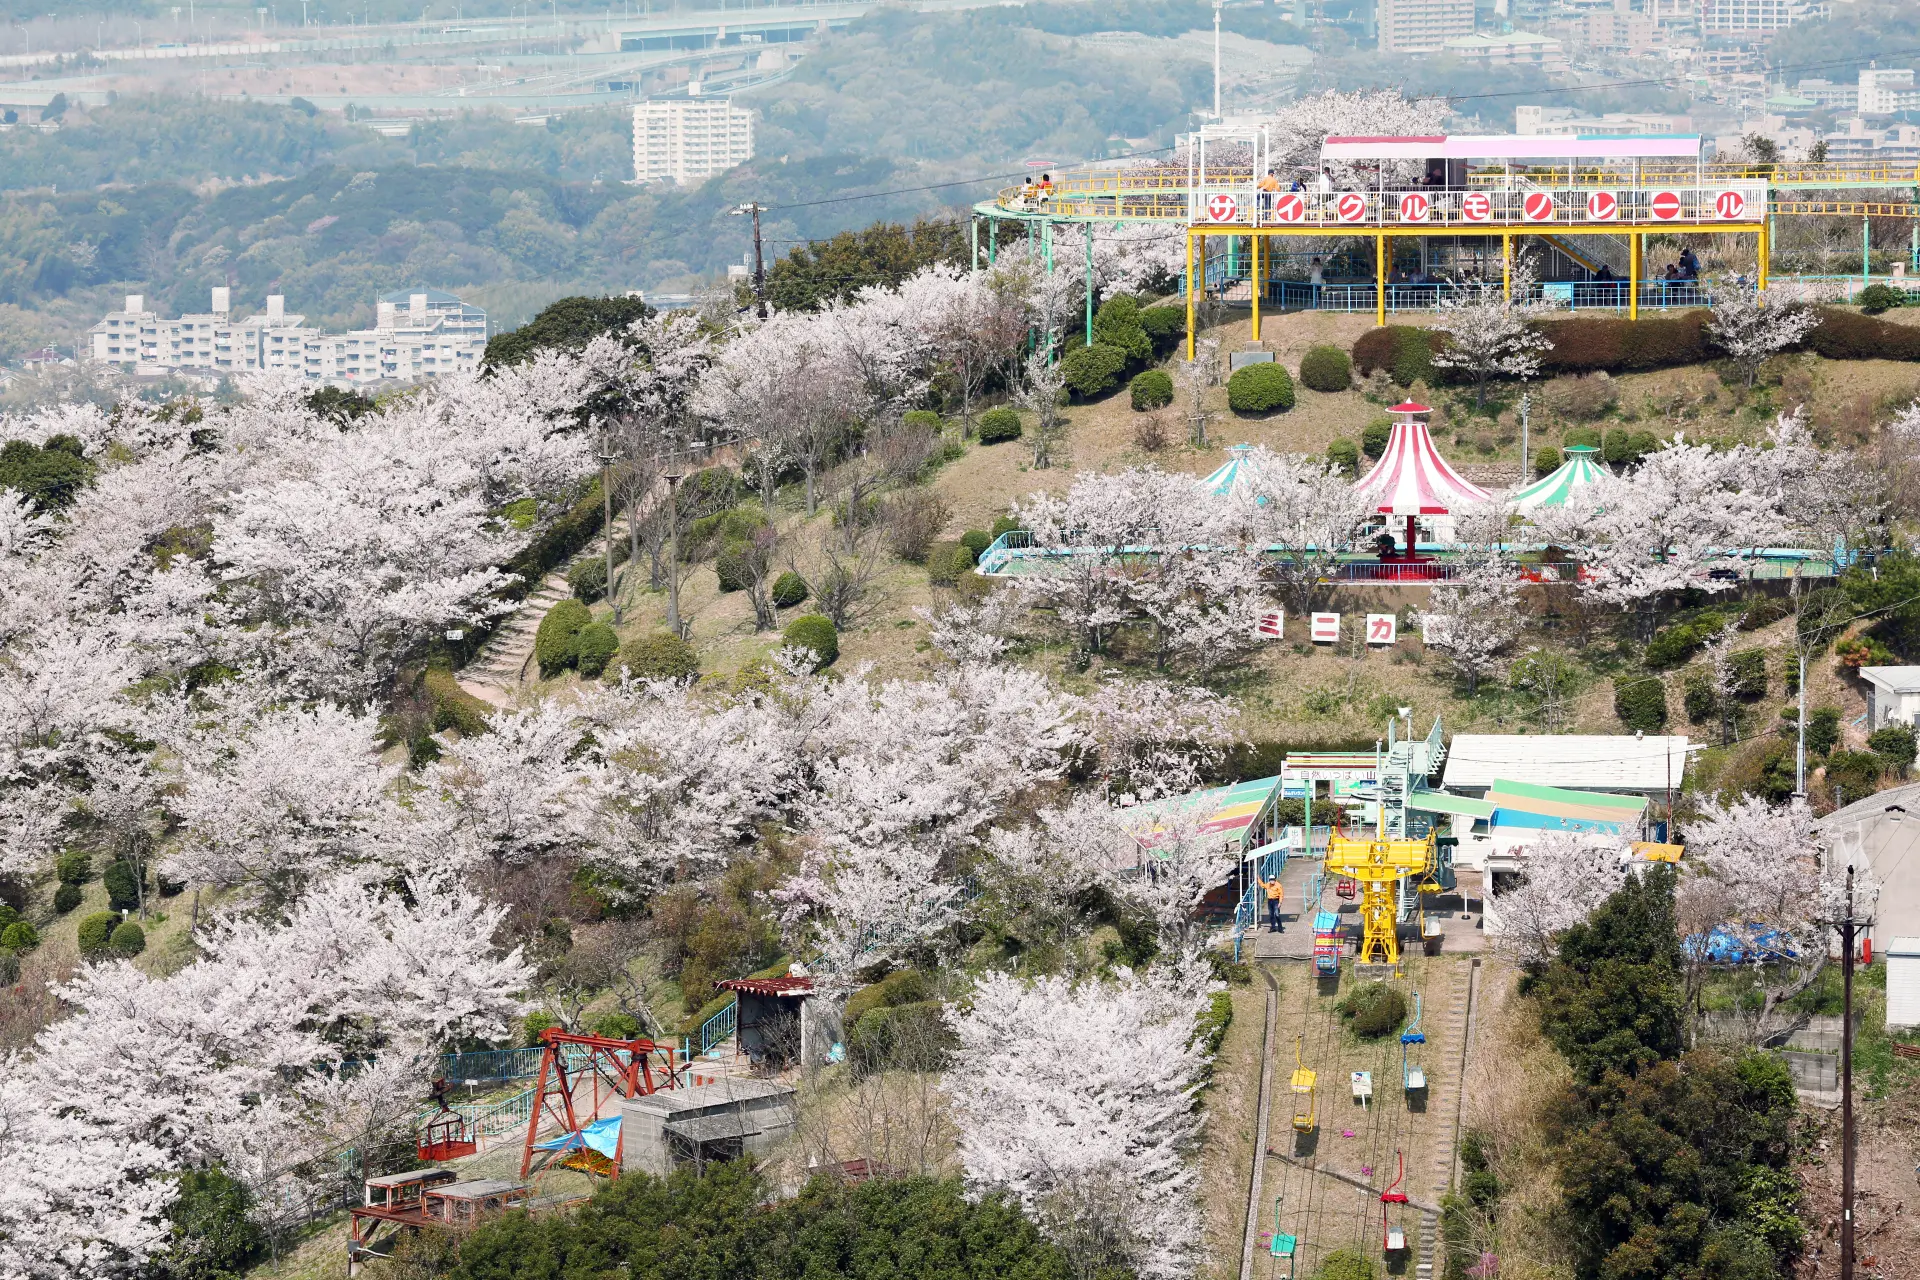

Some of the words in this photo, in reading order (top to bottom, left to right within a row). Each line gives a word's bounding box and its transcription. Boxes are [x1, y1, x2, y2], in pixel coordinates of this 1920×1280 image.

[1210, 195, 1743, 221] サイクルモノレール
[1258, 613, 1442, 641] ミニカ
